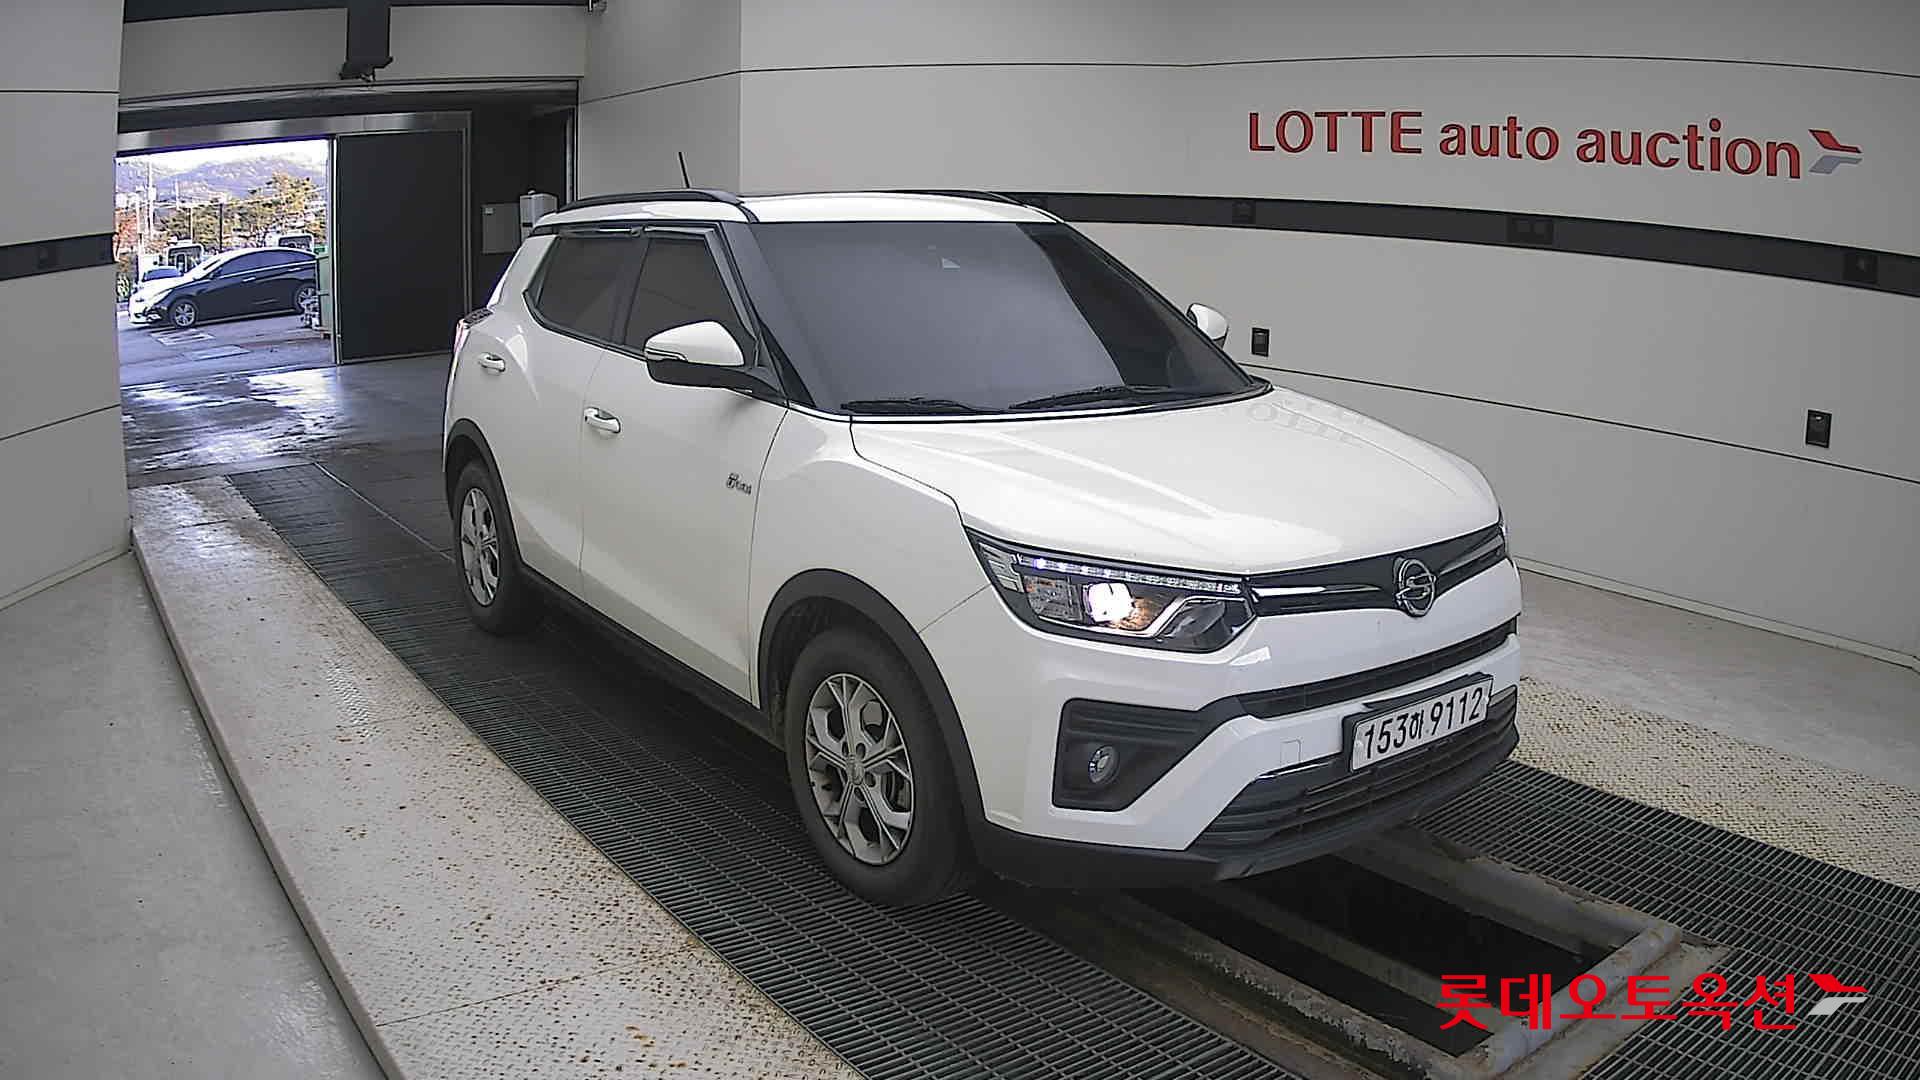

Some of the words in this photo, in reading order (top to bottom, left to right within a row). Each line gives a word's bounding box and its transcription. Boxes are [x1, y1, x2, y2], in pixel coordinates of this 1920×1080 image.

[1249, 110, 1422, 154] LOTTE
[1439, 115, 1560, 161] auto
[1576, 118, 1801, 179] auction
[1364, 709, 1425, 759] 153하
[1430, 687, 1483, 736] 9112
